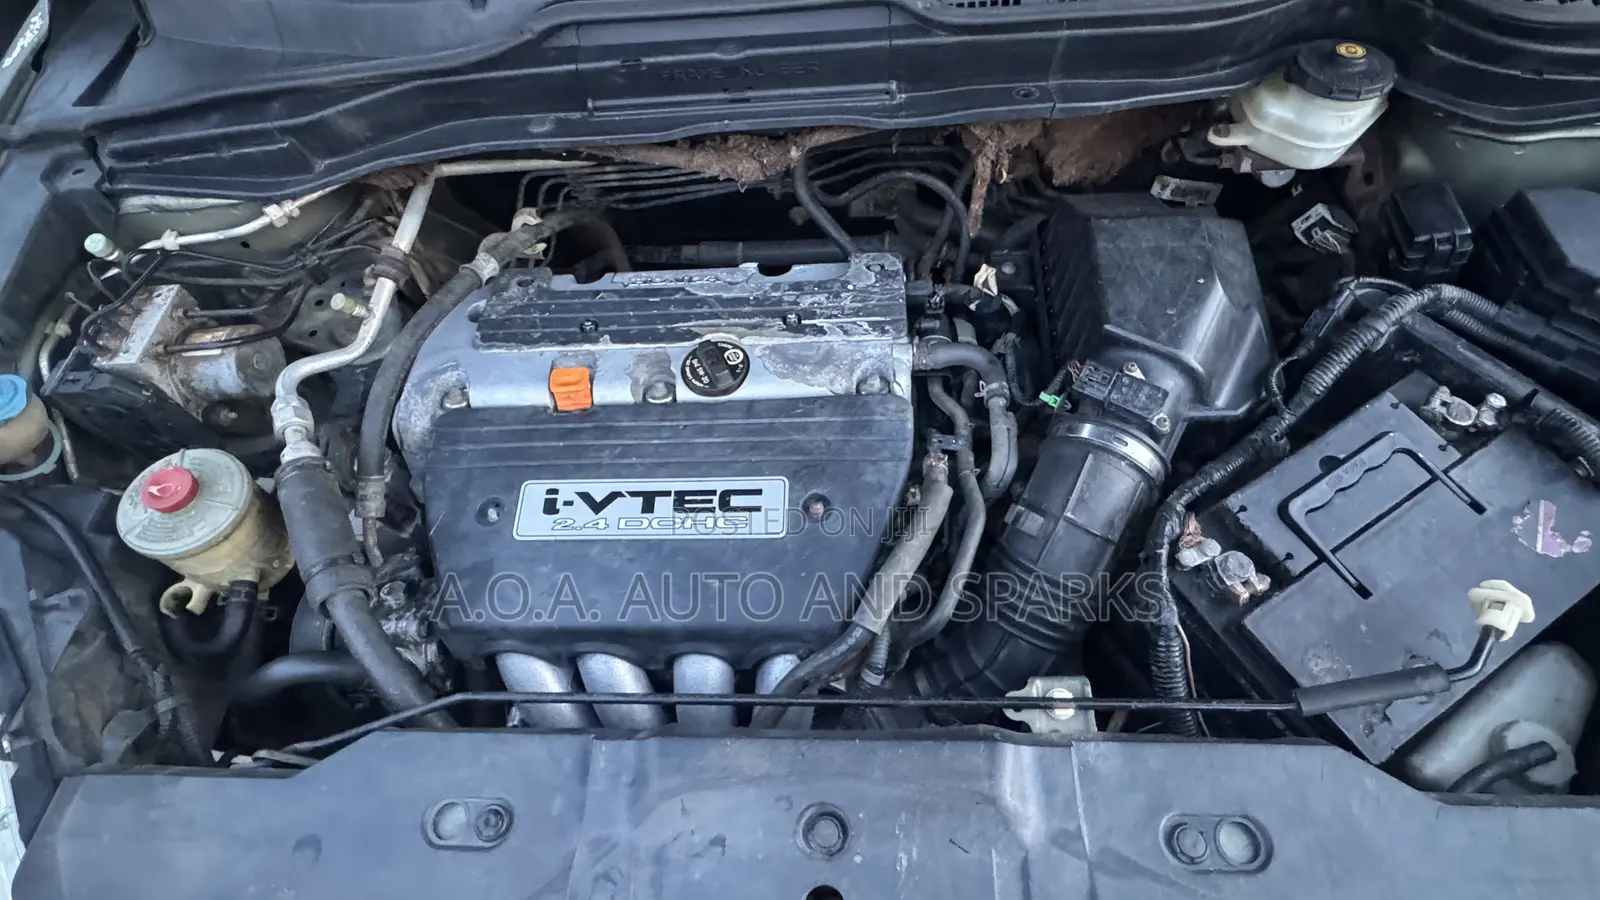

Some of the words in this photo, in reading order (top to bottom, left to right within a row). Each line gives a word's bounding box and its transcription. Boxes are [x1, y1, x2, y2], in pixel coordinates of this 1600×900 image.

[542, 488, 763, 515] i-VTEC
[551, 516, 609, 531] 2.4
[618, 515, 749, 531] DOHC
